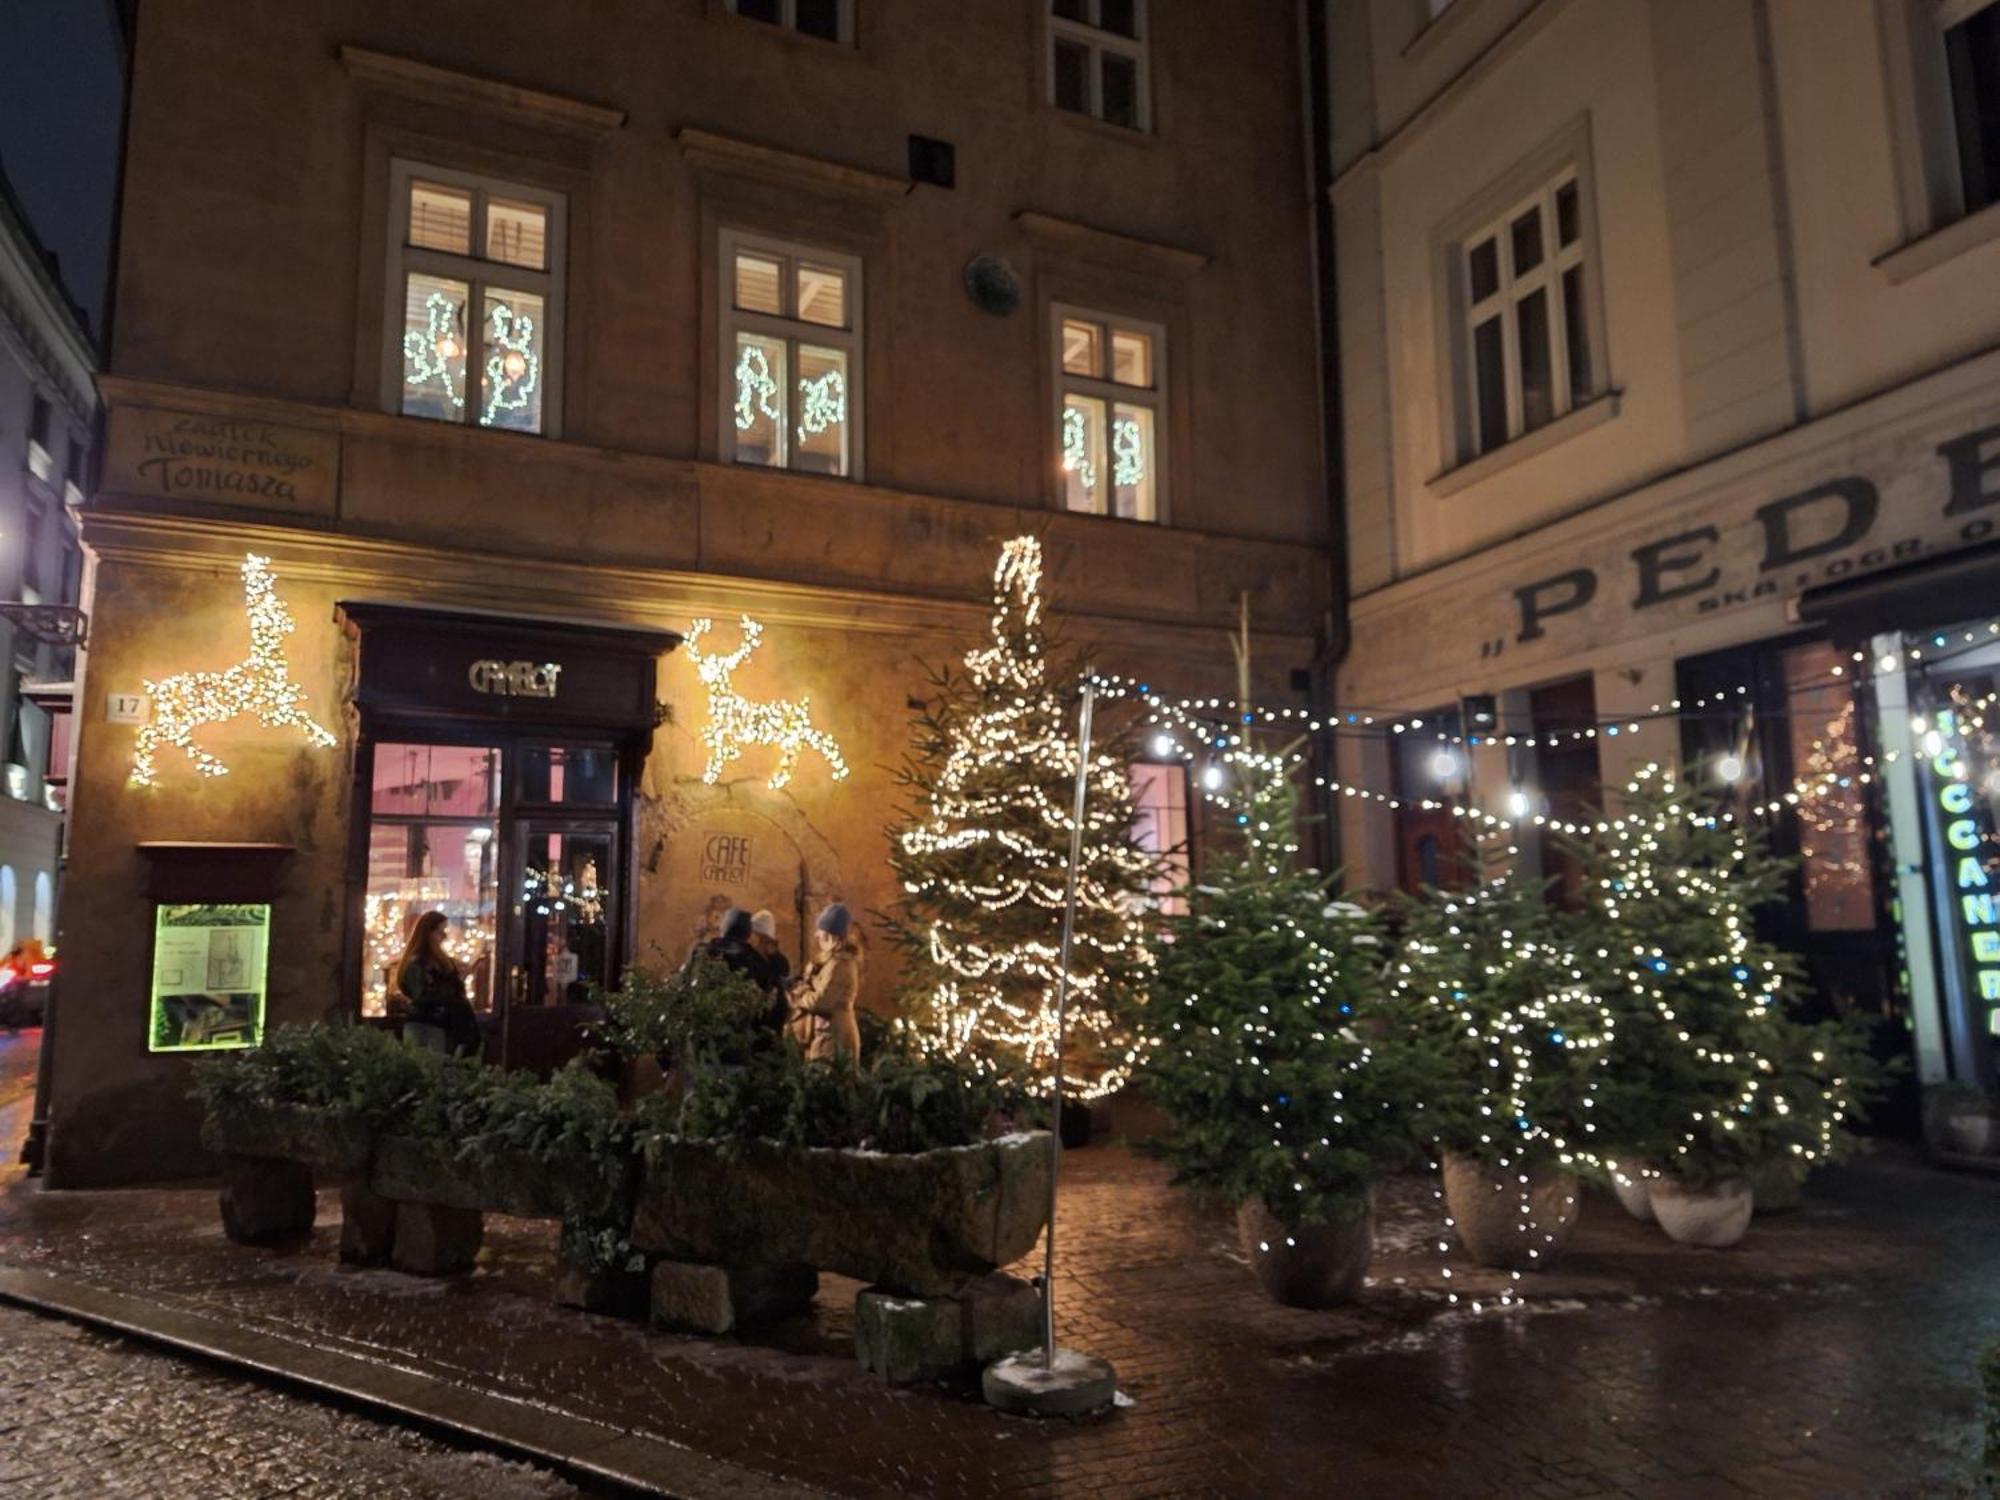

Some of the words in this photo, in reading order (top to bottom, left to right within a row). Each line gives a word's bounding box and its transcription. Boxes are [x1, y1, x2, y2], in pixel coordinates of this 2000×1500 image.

[136, 455, 297, 503] Tomasza
[118, 698, 140, 713] 17
[705, 835, 750, 866] CAFE
